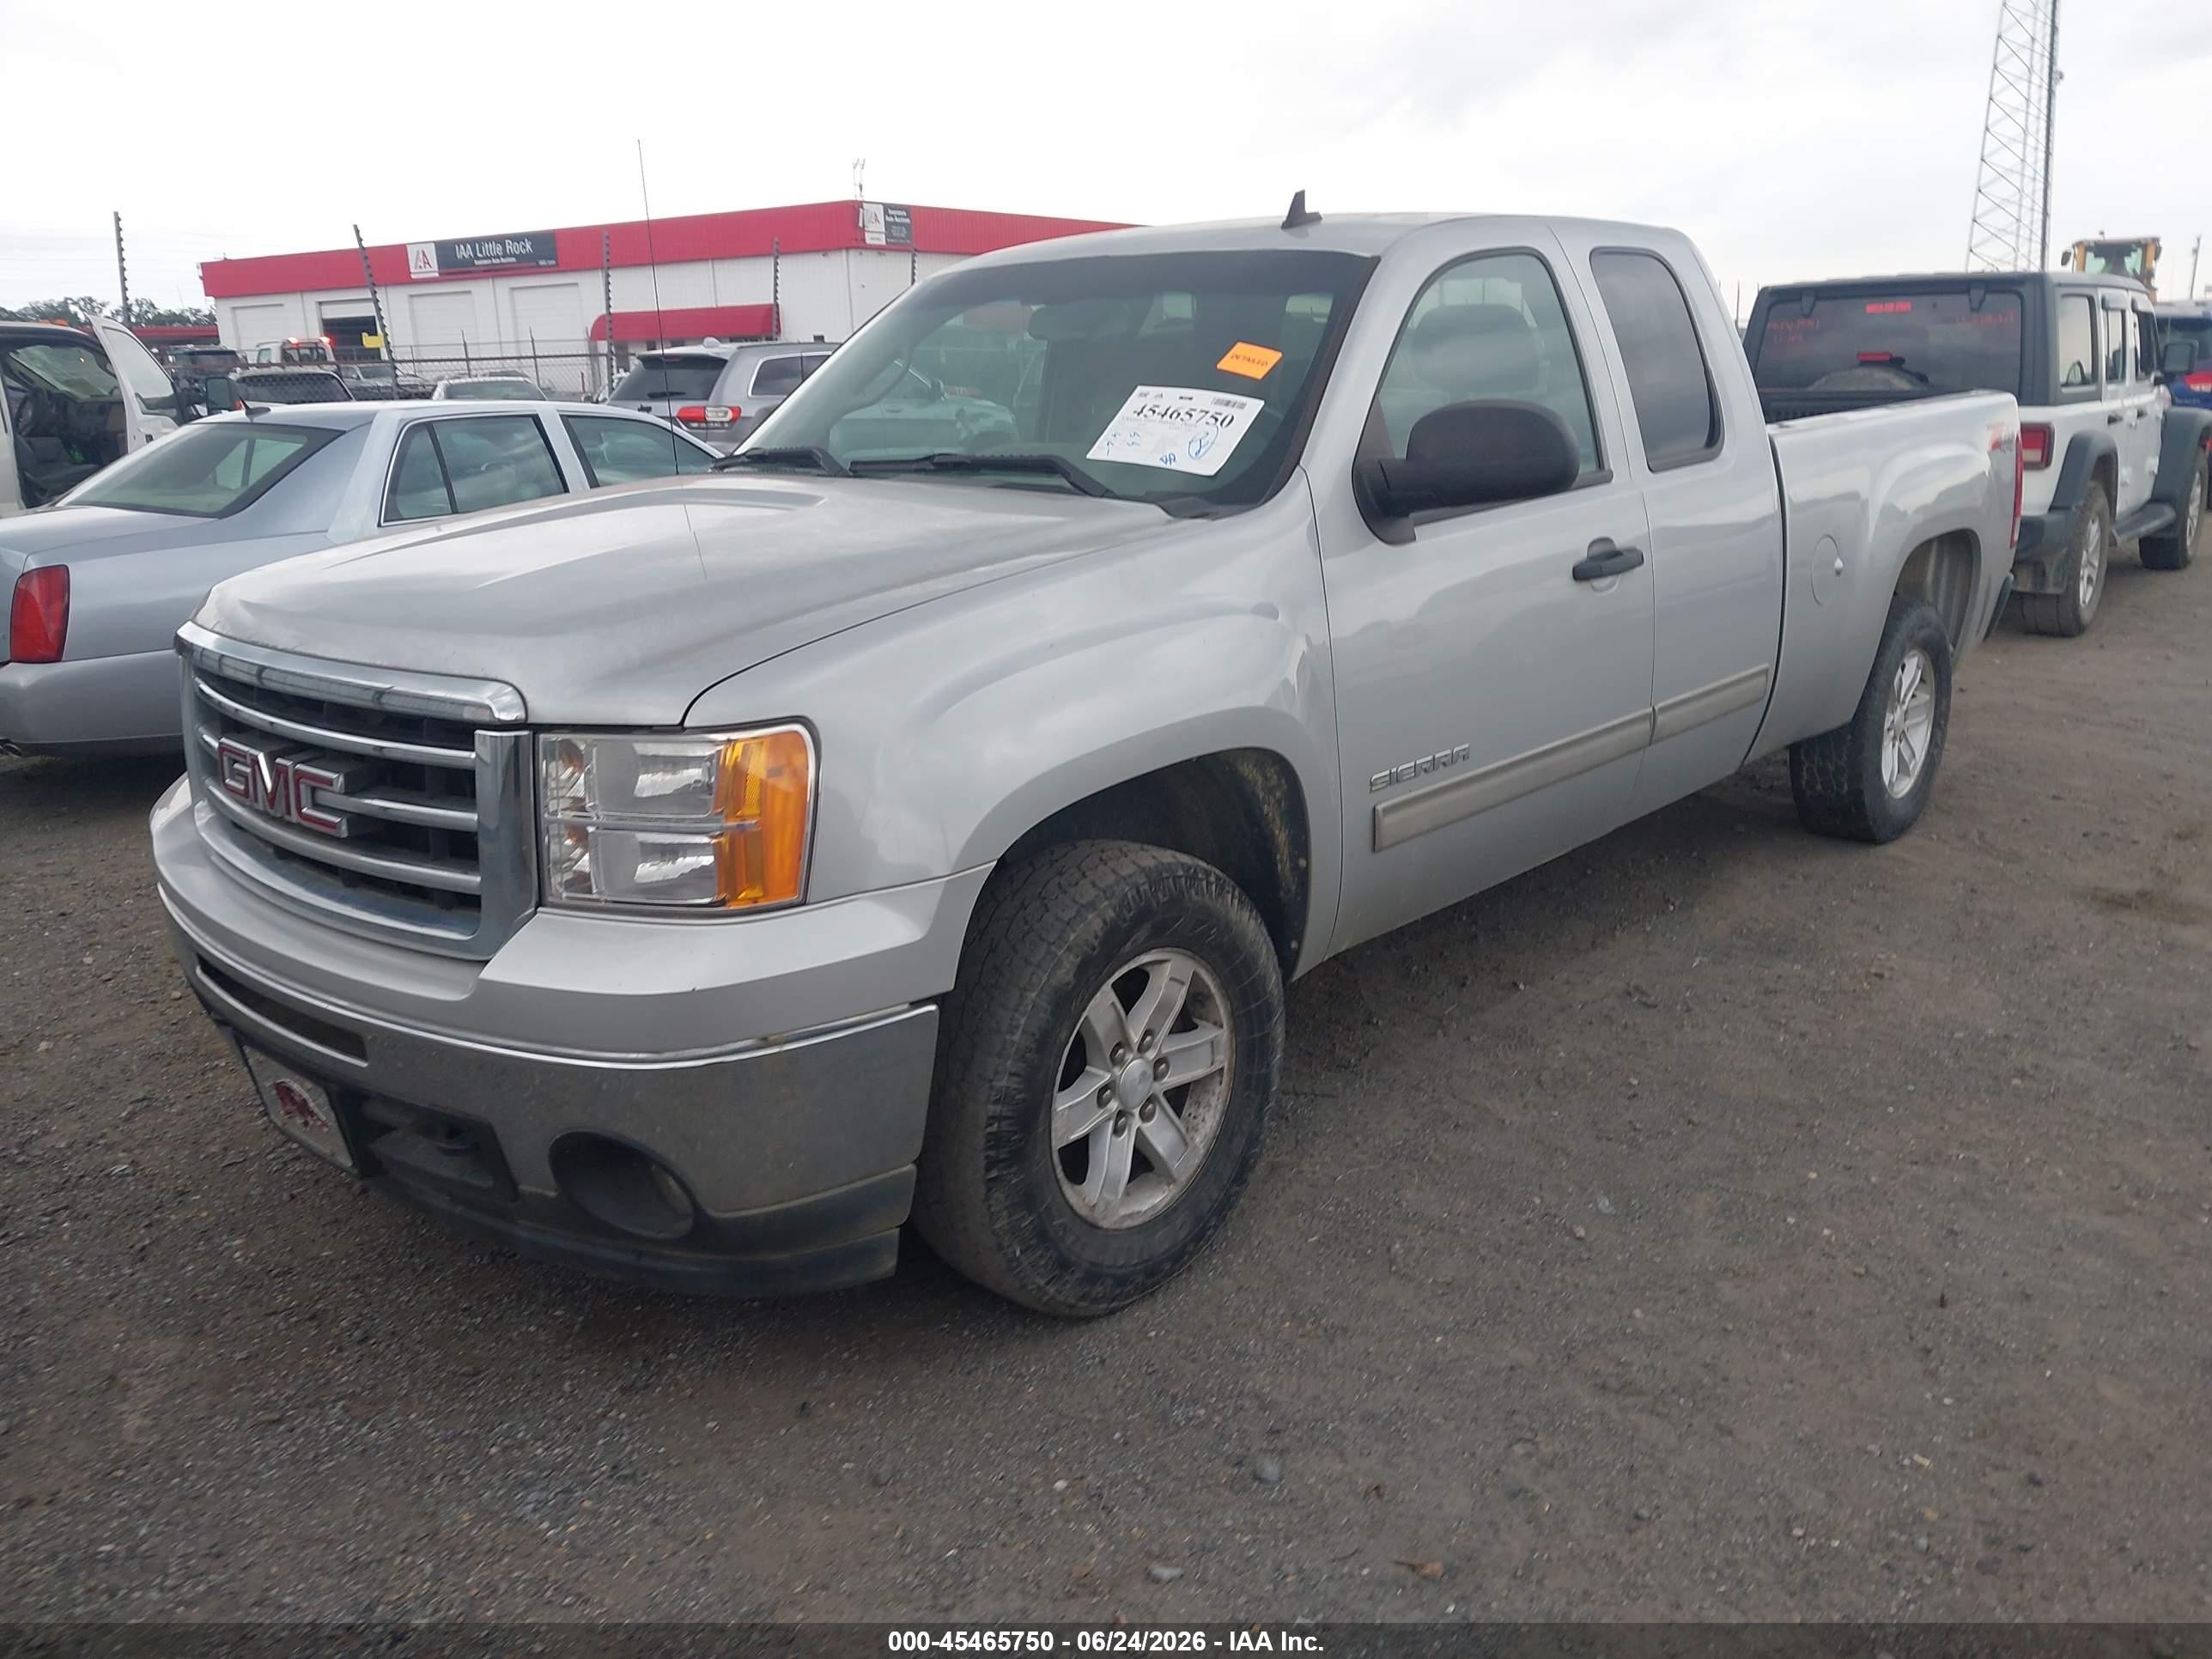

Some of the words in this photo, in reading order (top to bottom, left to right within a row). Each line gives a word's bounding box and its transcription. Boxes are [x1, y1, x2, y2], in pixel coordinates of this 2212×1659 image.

[455, 241, 474, 259] IAA
[475, 240, 503, 258] Little
[505, 237, 533, 255] Rock
[637, 404, 653, 414] Jeep
[1133, 403, 1235, 428] 45465750
[1369, 743, 1470, 793] SIERRA
[219, 737, 348, 838] GMC
